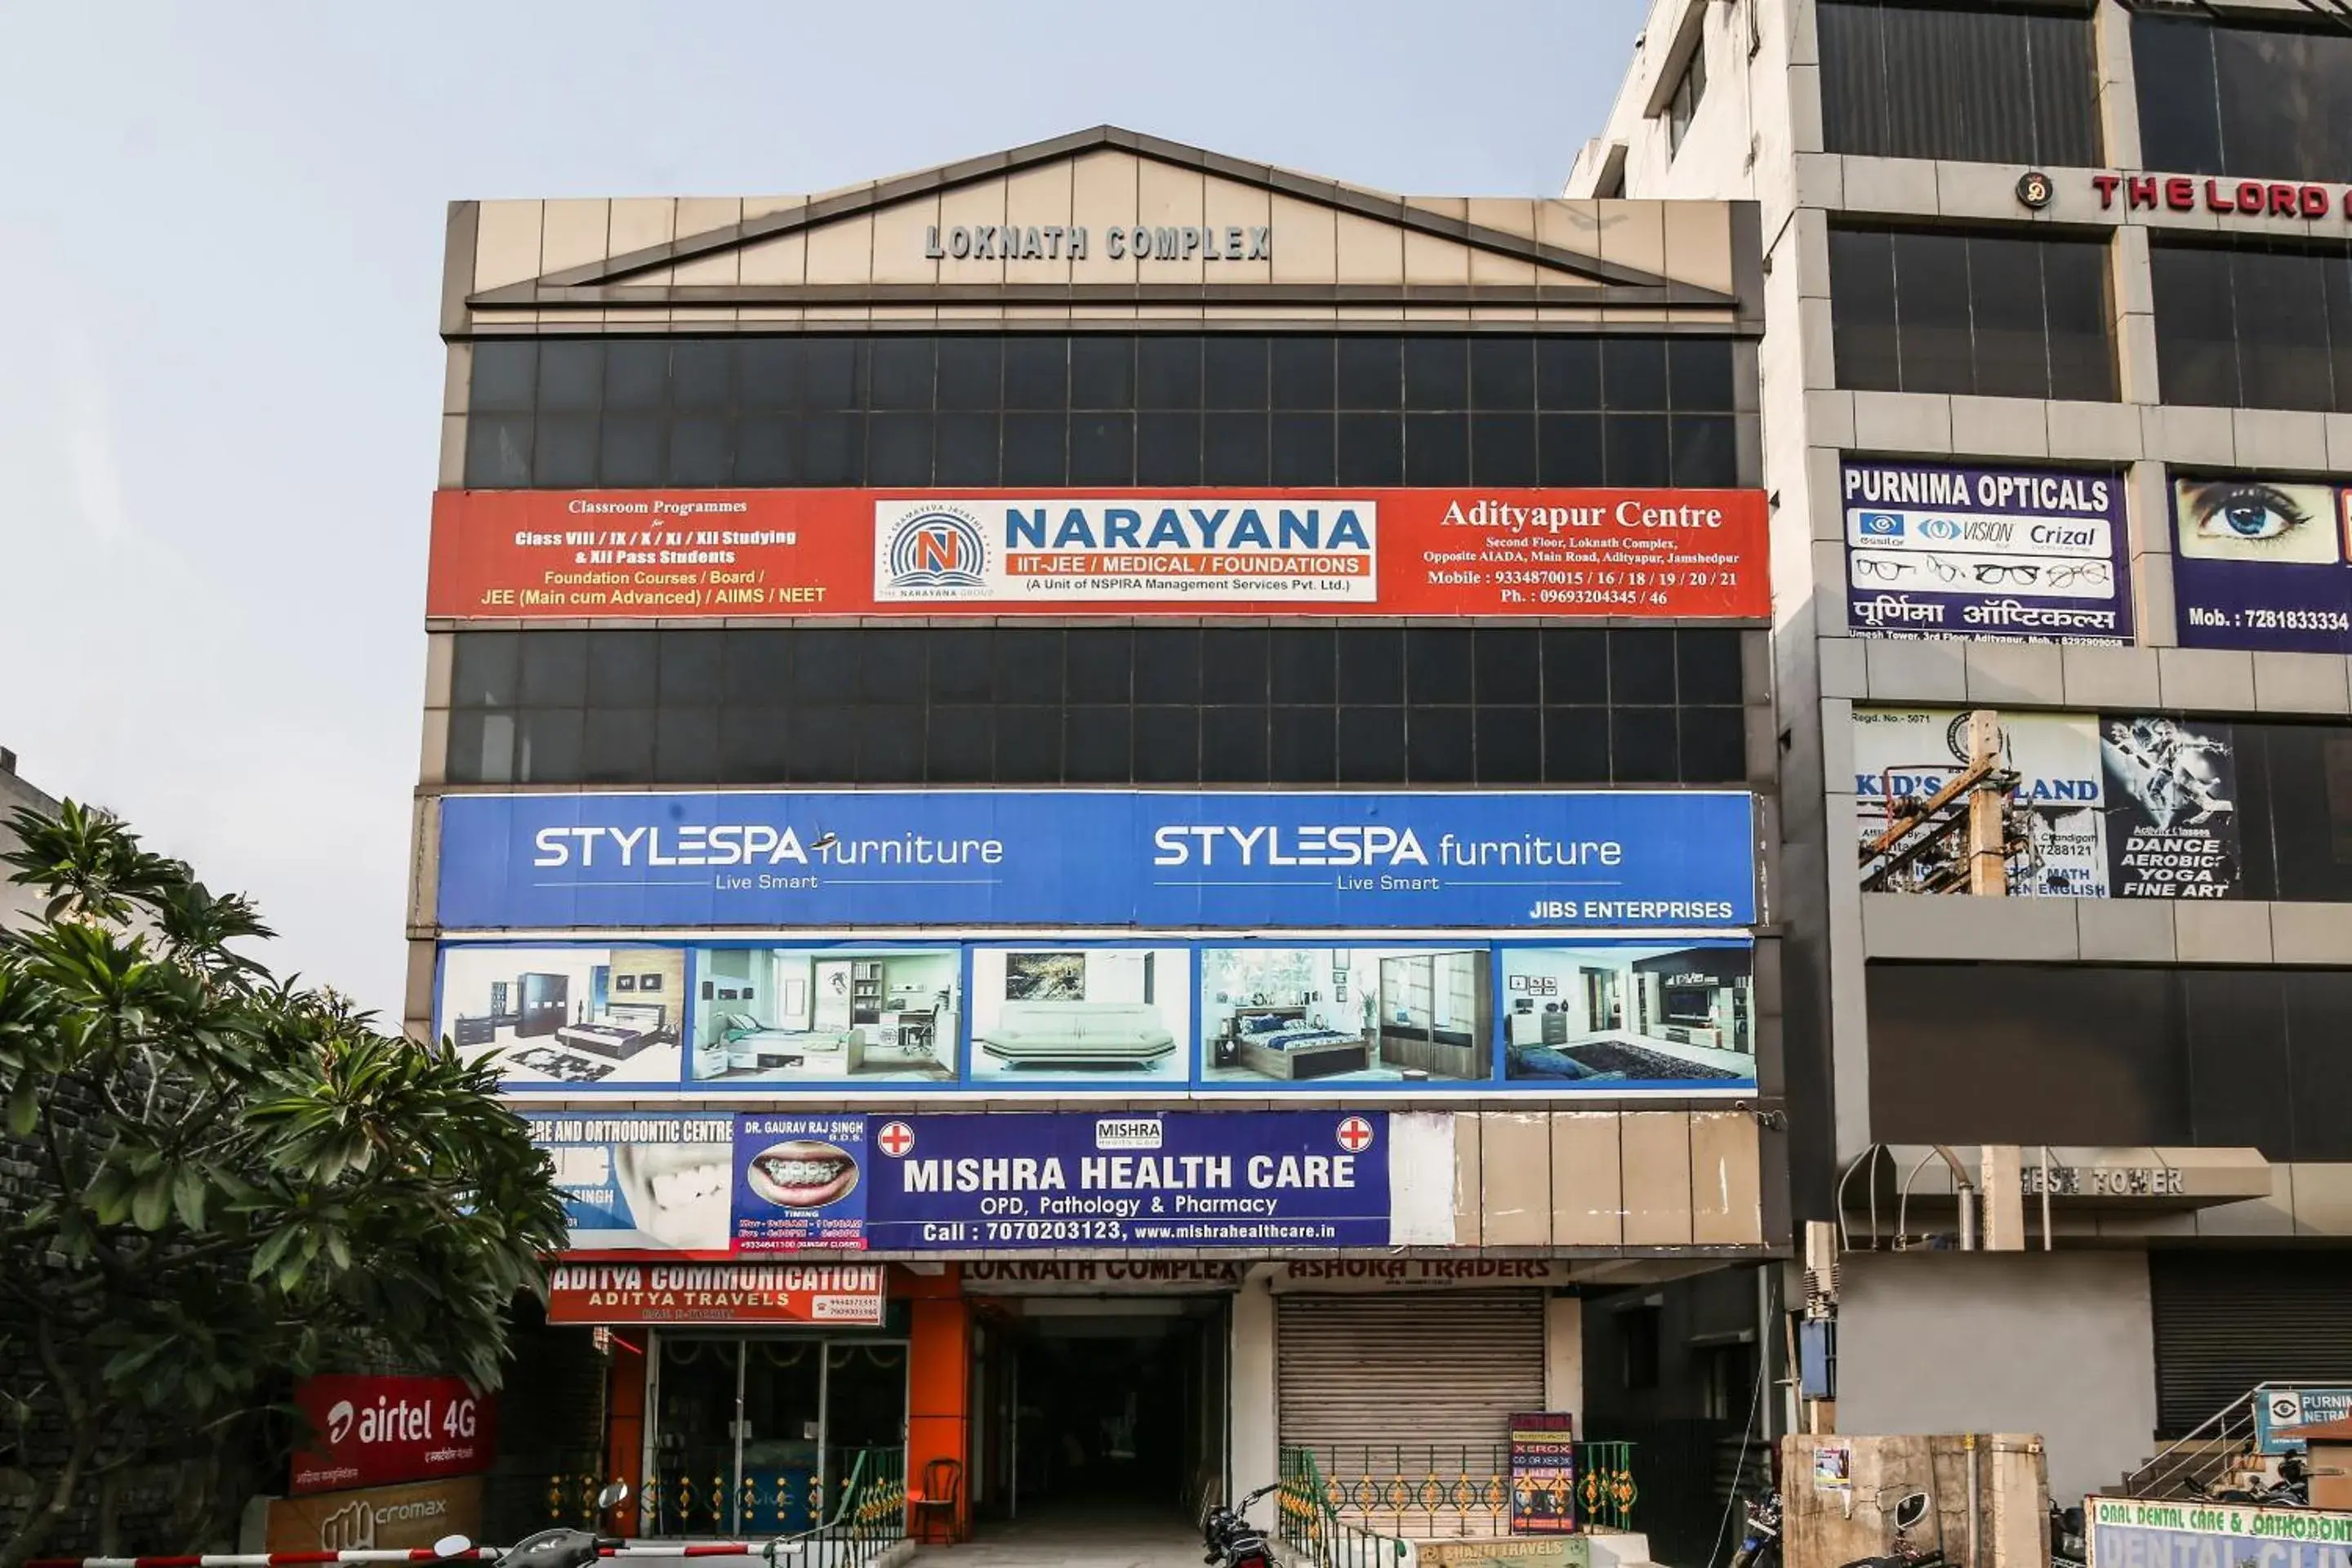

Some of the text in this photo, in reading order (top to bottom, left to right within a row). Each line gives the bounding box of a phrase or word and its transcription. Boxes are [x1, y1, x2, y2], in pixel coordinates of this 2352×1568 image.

[2093, 175, 2195, 212] THE
[2205, 179, 2329, 218] LORD
[925, 225, 1269, 261] LOKNATH COMPLEX
[1845, 469, 2109, 512] PURNIMA OPTICALS
[568, 500, 747, 516] Classroom Programmes
[1441, 500, 1723, 533] Adityapur Centre
[515, 531, 796, 546] Class VIII IX X XI XII Studying
[1005, 508, 1371, 550] NARAYANA
[1963, 521, 2014, 543] VISION
[2030, 524, 2096, 546] Crizal
[917, 531, 957, 569] N
[1486, 537, 1678, 550] Second Floor, Loknath Complex,
[576, 550, 735, 564] & XII Pass Students
[1018, 556, 1360, 573] IIT-JEE MEDICAL FOUNDATIONS
[1423, 551, 1476, 564] Opposite
[1531, 551, 1563, 562] Main
[1566, 551, 1600, 564] Road,
[1603, 552, 1664, 565] Adityapur,
[1667, 553, 1740, 565] Jamshedpur
[545, 570, 755, 584] Foundation Courses Board
[1026, 578, 1350, 592] (A Unit of NSPIRA Management Services Pvt. Ltd.)
[1428, 572, 1737, 586] Mobile 9334870015 16 18 19 20 21
[482, 587, 826, 608] JEE (Main cum Advanced) AIIMS NEET
[1501, 590, 1526, 602] Ph.
[1650, 591, 1668, 605] 46
[1853, 595, 1944, 626] पूर्णिमा
[2189, 608, 2350, 630] Mob. 7281833334
[533, 826, 808, 866] STYLESPA
[1153, 826, 1622, 866] STYLESPA furniture
[2126, 838, 2221, 853] DANCE
[715, 874, 818, 889] Live Smart
[1338, 875, 1439, 890] Live Smart
[2137, 869, 2213, 882] YOGA
[2123, 883, 2229, 898] FINE ART
[1530, 902, 1732, 920] JIBS ENTERPRISES
[555, 1120, 582, 1143] AND
[584, 1120, 679, 1143] ORTHODONTIC
[683, 1120, 733, 1143] CENTRE
[745, 1121, 863, 1134] DR. GAURAV RAJ SINGH
[1098, 1124, 1160, 1136] MISHRA
[903, 1155, 1355, 1192] MISHRA HEALTH CARE
[2091, 1168, 2184, 1194] TOWER
[980, 1195, 1277, 1216] OPD, Pathology & Pharmacy
[923, 1222, 1336, 1244] Call 7070203123, www.mishrahealthcare.in
[553, 1266, 877, 1291] ADITYA COMMUNICATION
[962, 1260, 1097, 1280] LOKNATH
[1420, 1259, 1550, 1280] TRADERS
[589, 1292, 790, 1306] ADITYA TRAVELS
[359, 1395, 476, 1443] airtel 4G
[2100, 1503, 2132, 1523] ORAL
[2137, 1507, 2185, 1529] DENTAL
[2189, 1509, 2224, 1530] CARE
[2230, 1512, 2242, 1532] &
